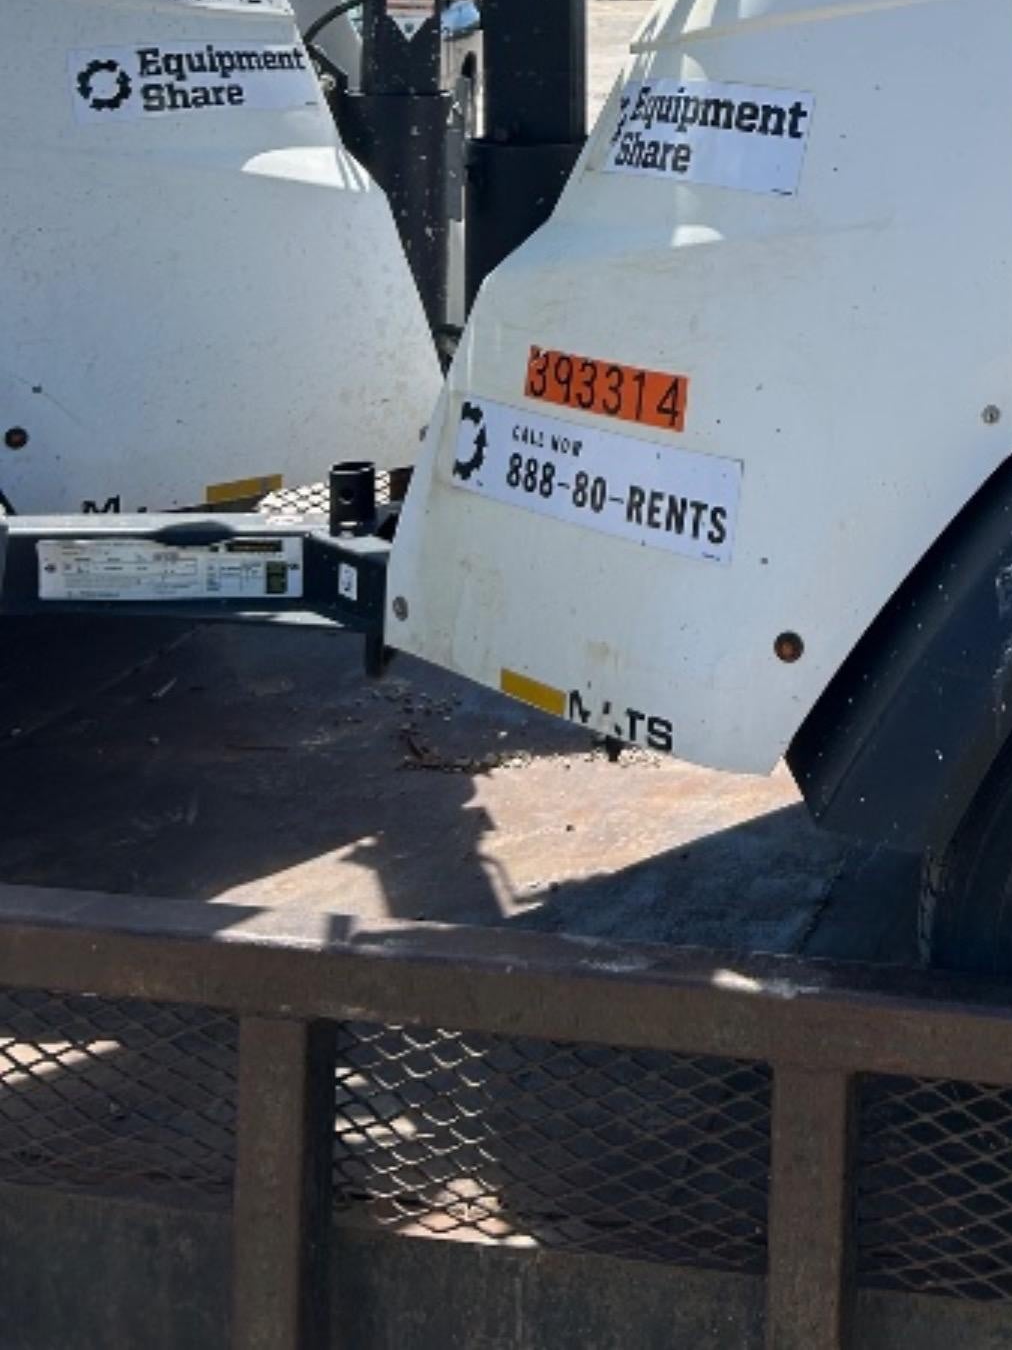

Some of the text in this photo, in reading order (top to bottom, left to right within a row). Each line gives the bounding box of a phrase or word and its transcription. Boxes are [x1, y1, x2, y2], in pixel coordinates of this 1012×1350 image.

[138, 45, 304, 80] Equipment
[140, 83, 244, 111] Share
[630, 86, 807, 138] Equipment
[614, 131, 691, 173] Share
[530, 350, 681, 427] 393314
[505, 452, 728, 545] 888-80-RENTS
